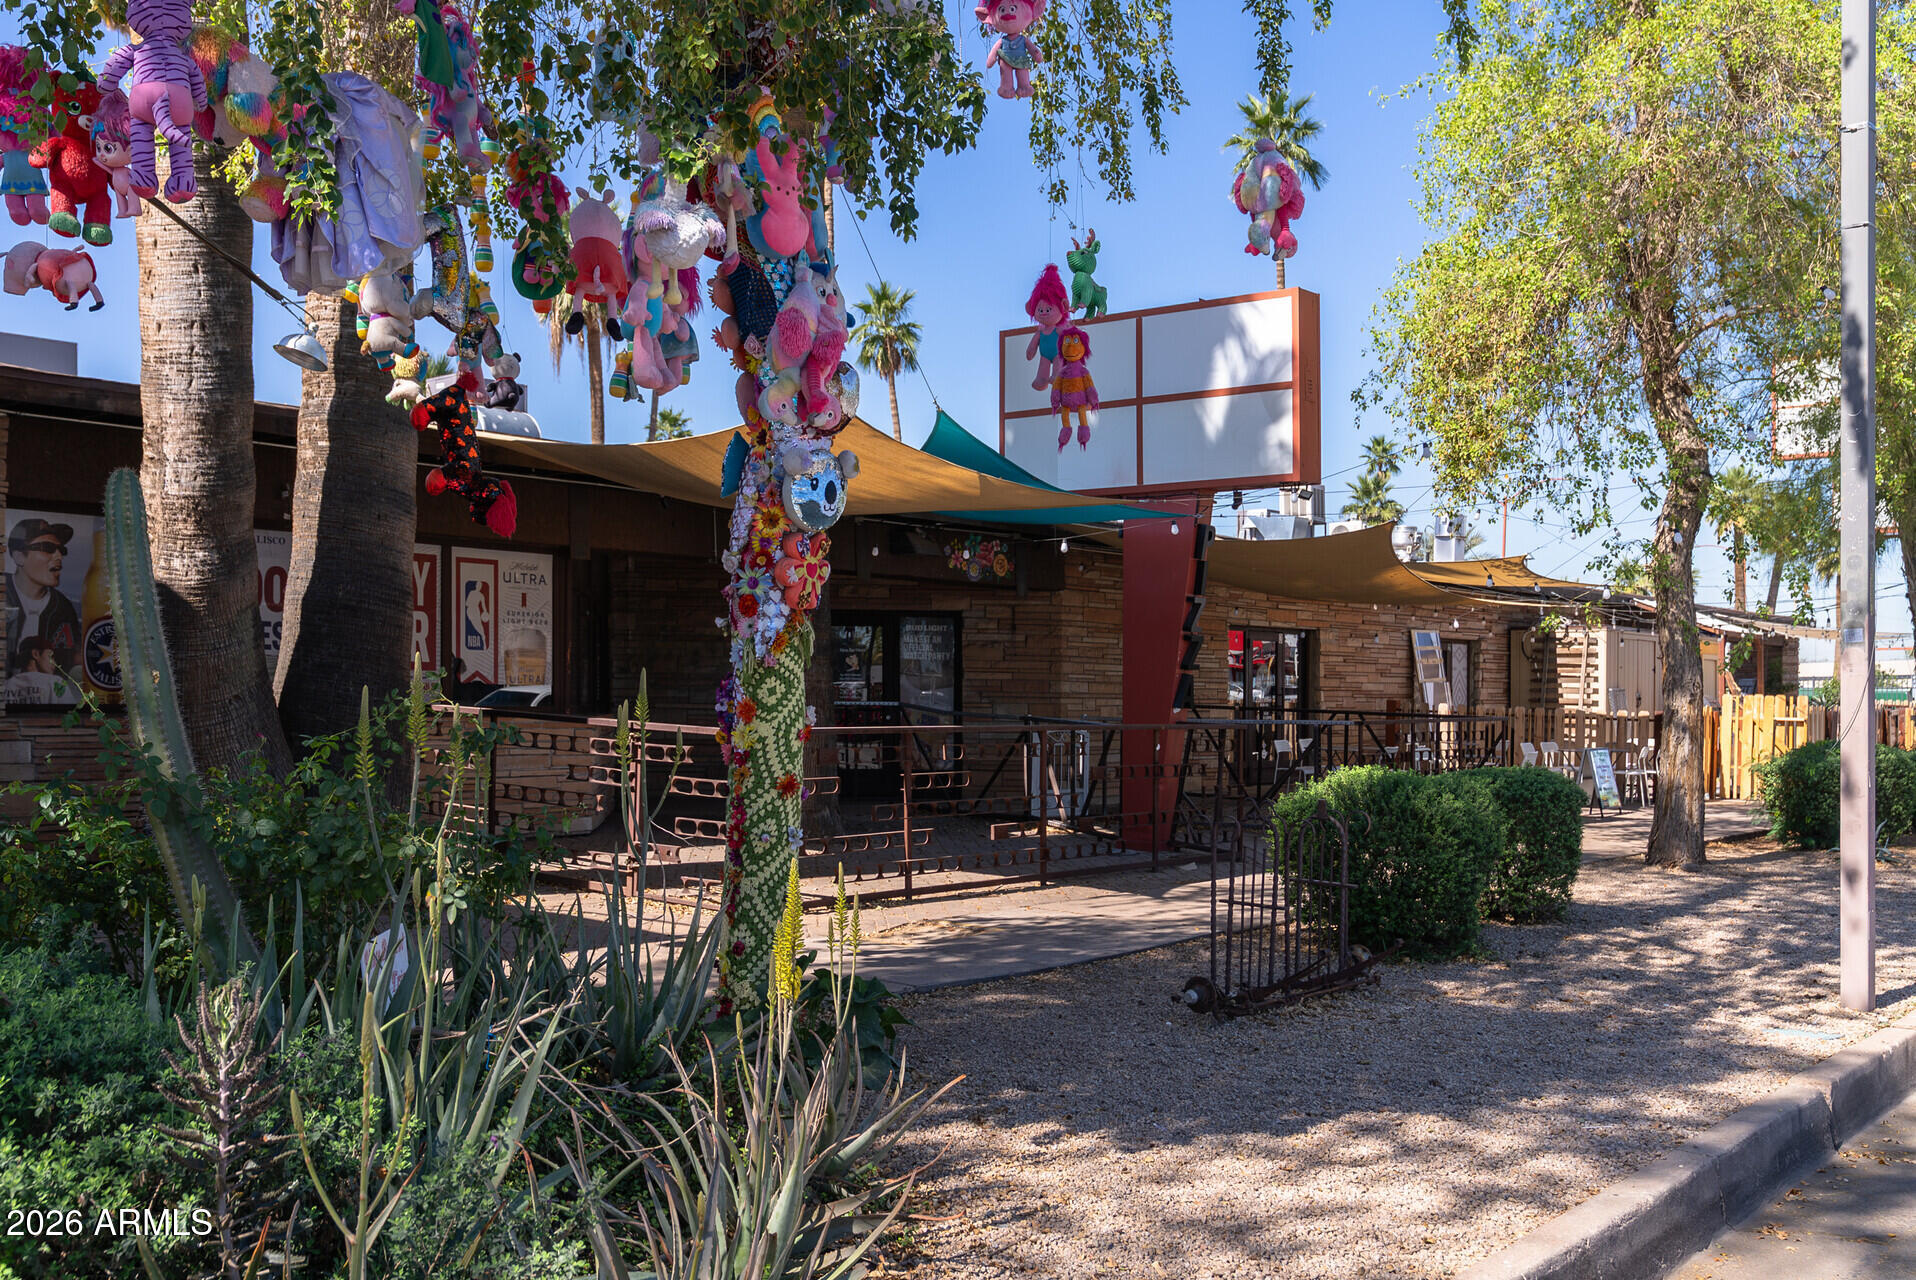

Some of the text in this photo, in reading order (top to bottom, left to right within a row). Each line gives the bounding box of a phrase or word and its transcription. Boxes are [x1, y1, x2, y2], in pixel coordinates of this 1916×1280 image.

[256, 535, 286, 545] LISCO
[503, 571, 547, 585] ULTRA
[1173, 523, 1216, 709] PIZZA
[467, 635, 481, 648] NBA
[93, 670, 122, 686] JALIS
